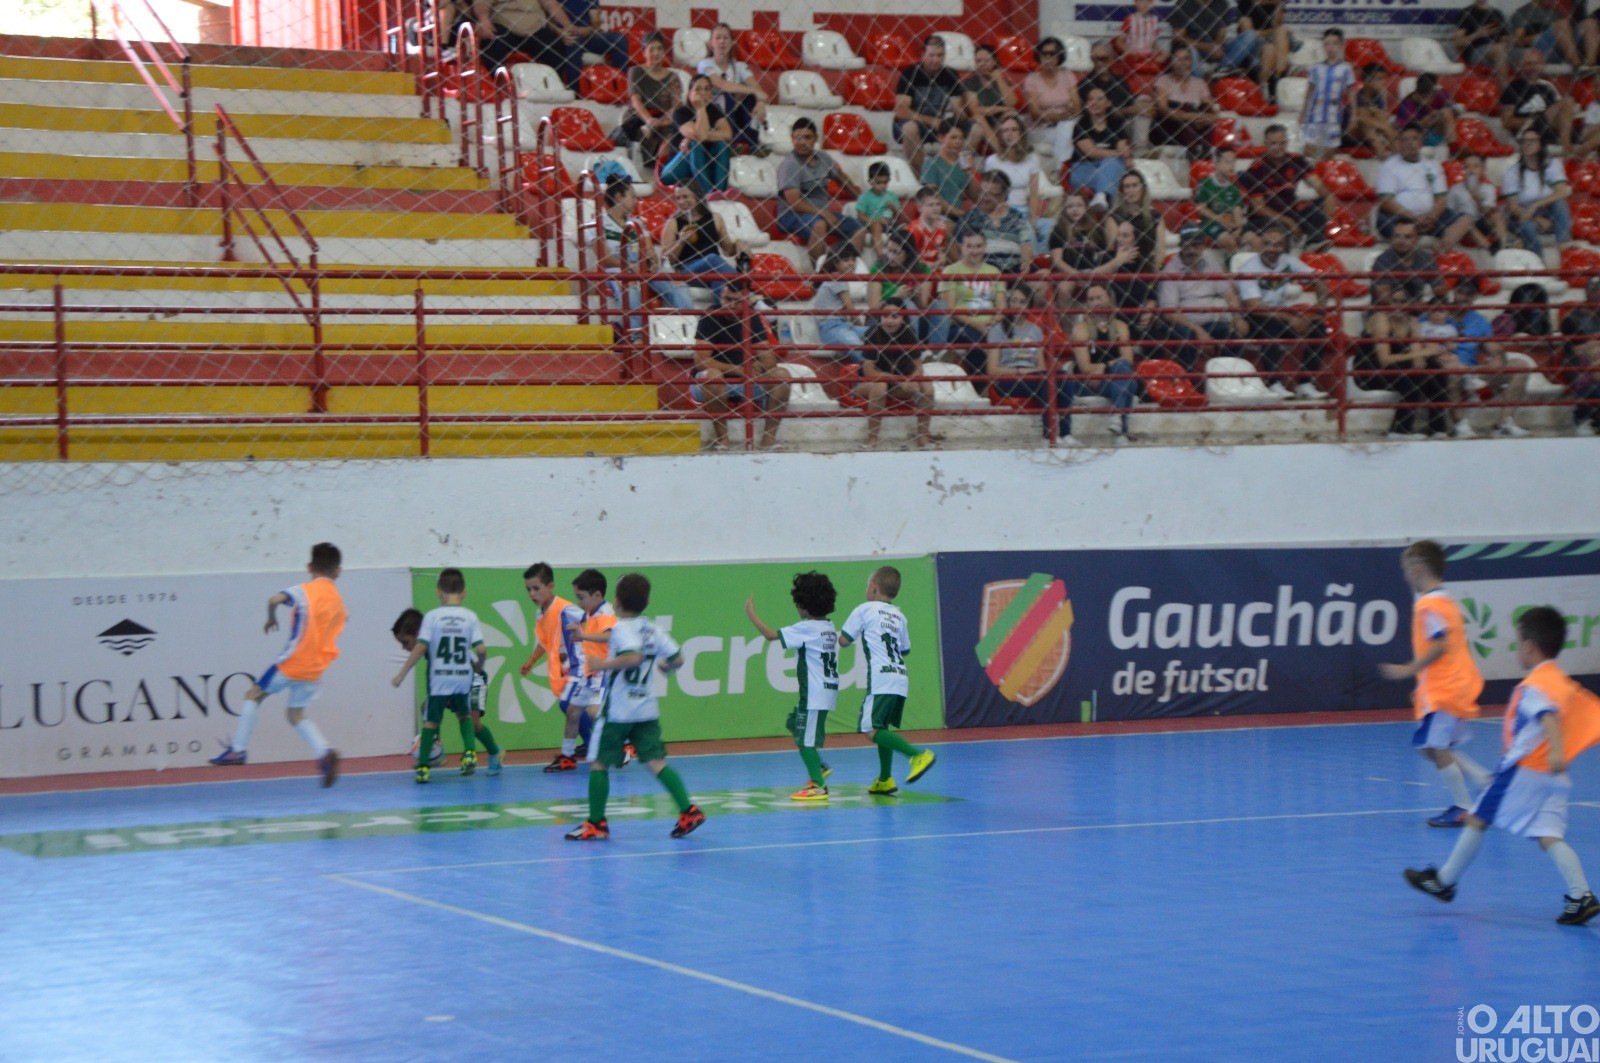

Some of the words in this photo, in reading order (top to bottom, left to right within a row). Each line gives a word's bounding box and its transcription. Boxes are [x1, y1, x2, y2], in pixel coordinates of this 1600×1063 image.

[73, 594, 127, 607] DESDE
[138, 592, 178, 605] 1976
[1108, 582, 1399, 650] Gauchão
[436, 636, 467, 665] 45
[1112, 661, 1156, 696] de
[1157, 658, 1269, 703] futsal
[57, 740, 203, 761] GRAMADO
